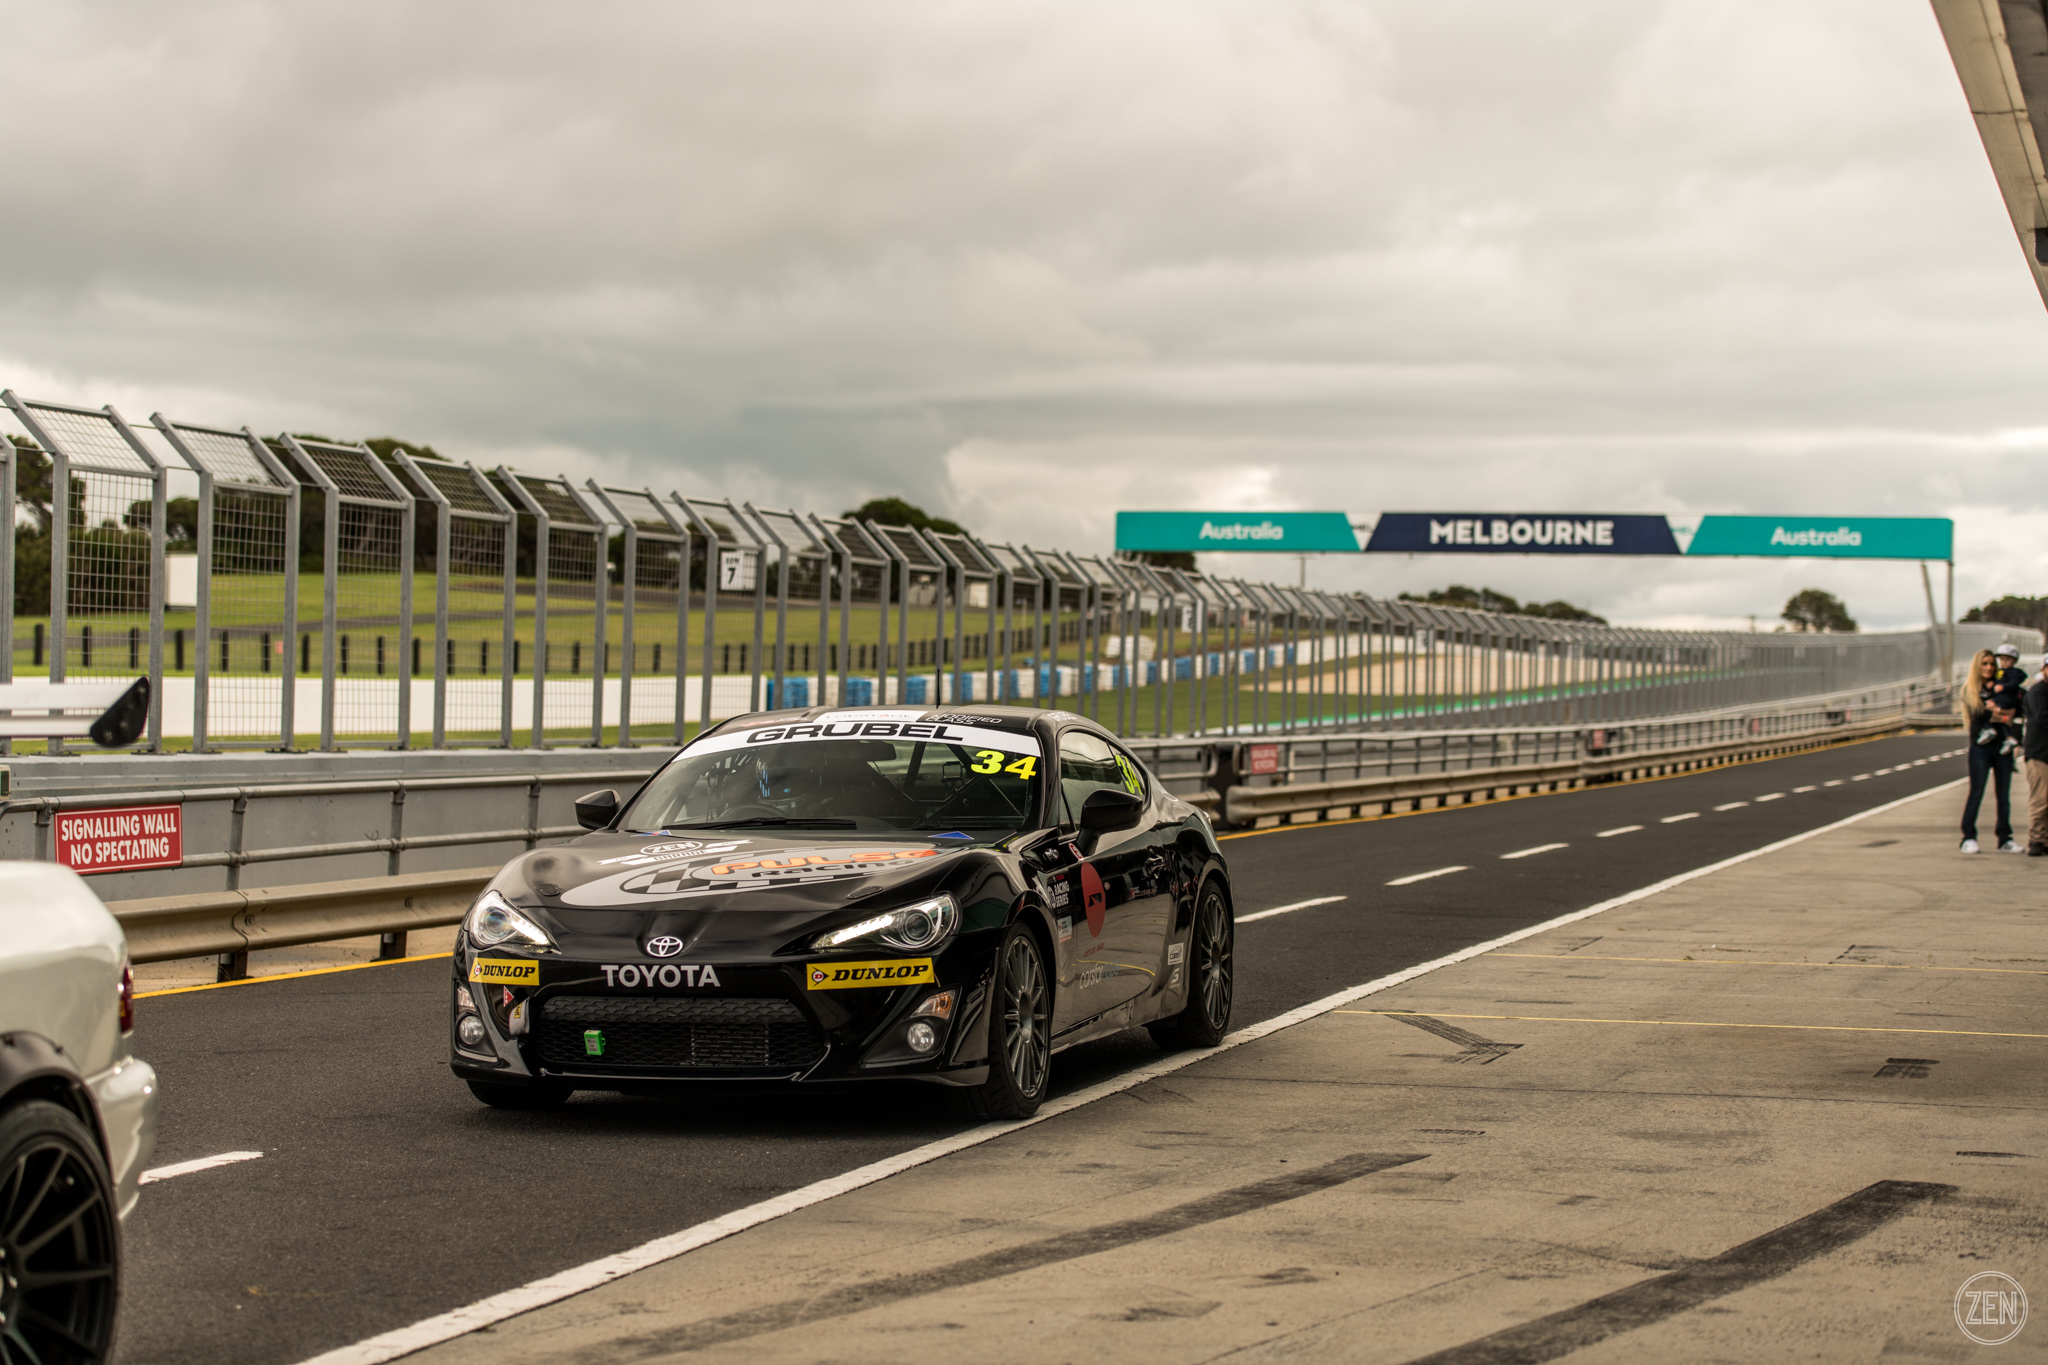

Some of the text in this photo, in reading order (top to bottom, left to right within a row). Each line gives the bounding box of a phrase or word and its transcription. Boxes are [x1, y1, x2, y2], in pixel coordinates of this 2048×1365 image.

[1199, 520, 1285, 540] Australia
[1429, 519, 1615, 546] MELBOURNE
[1769, 526, 1862, 547] Australia
[728, 567, 736, 584] 7
[925, 716, 974, 725] CLASS
[930, 712, 1003, 725] MODIFIED
[746, 722, 964, 744] GRUBEL
[970, 750, 1038, 780] 34
[1114, 753, 1144, 796] 34
[61, 812, 177, 841] SIGNALLING WALL
[70, 837, 169, 865] NO SPECTATING
[652, 841, 698, 853] ZEN
[482, 964, 536, 978] DUNLOP
[600, 964, 721, 988] TOYOTA
[831, 964, 929, 982] DUNLOP
